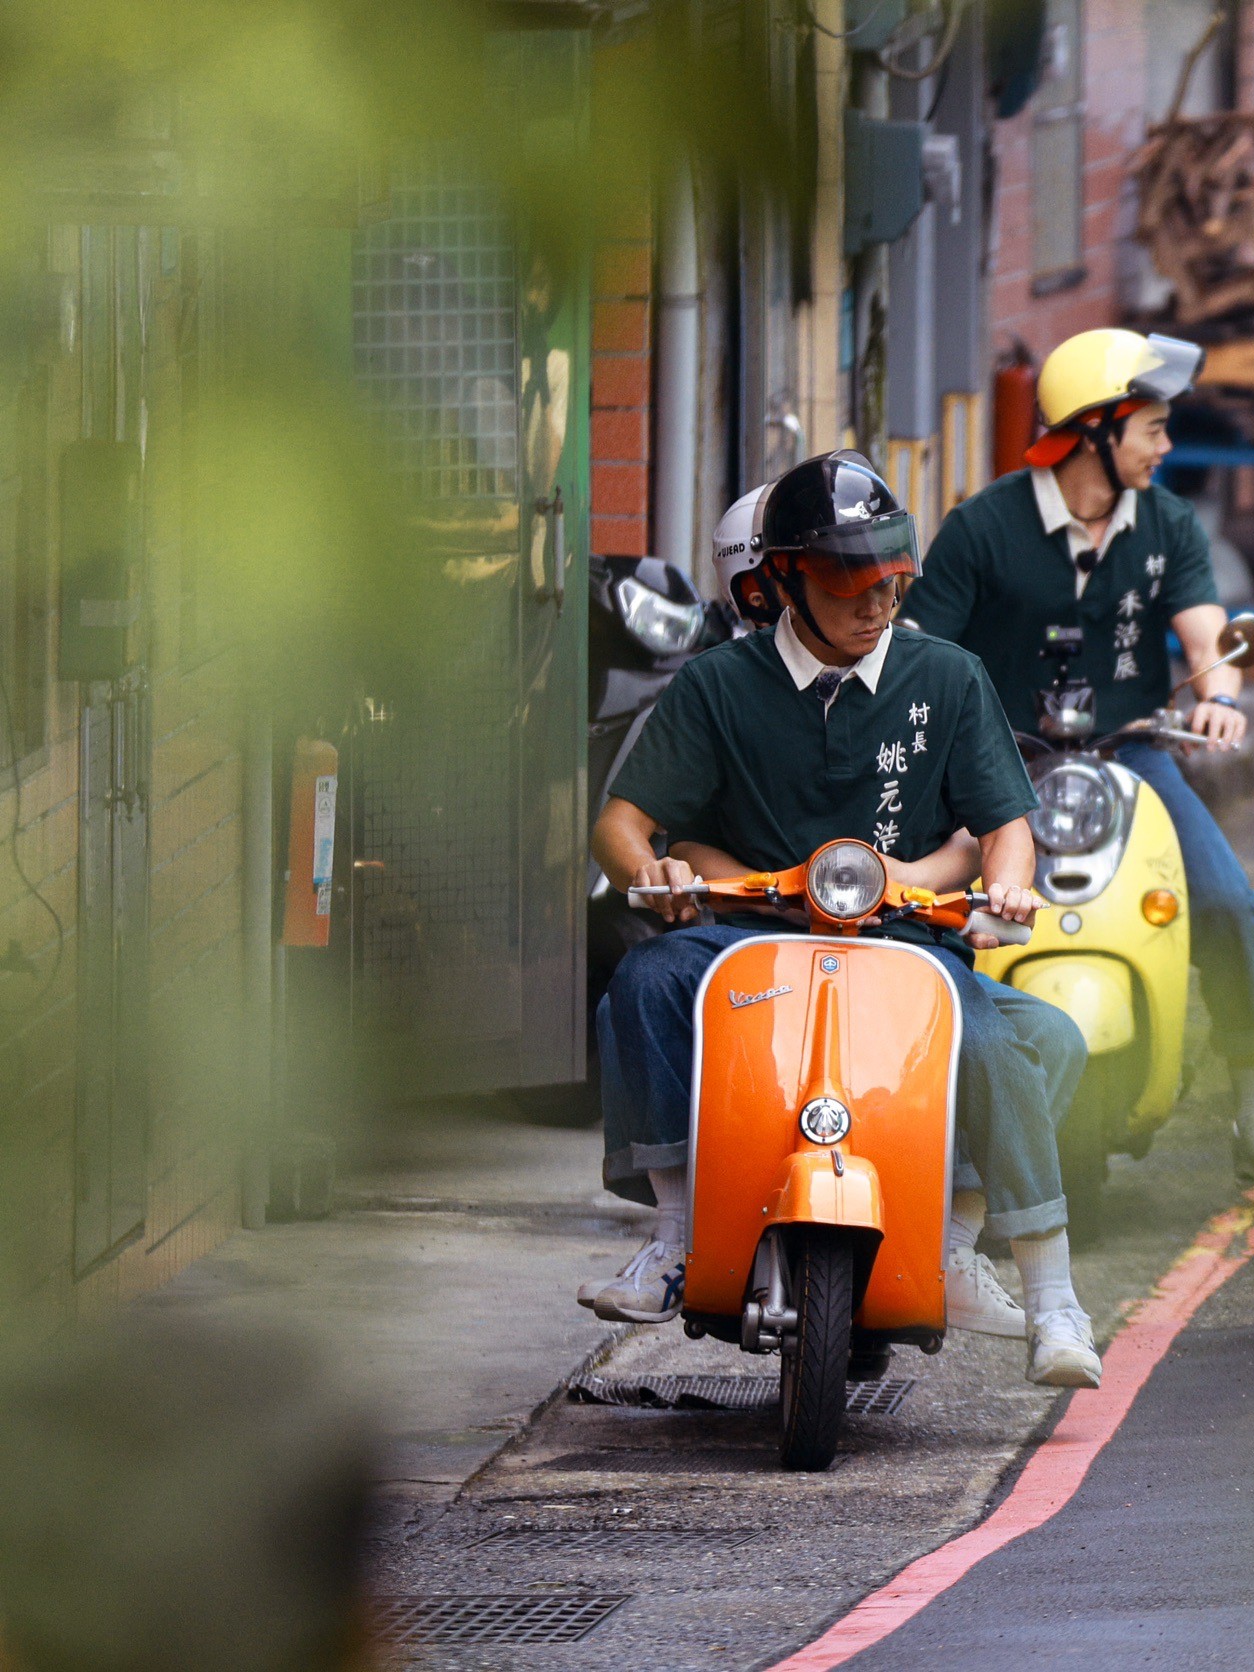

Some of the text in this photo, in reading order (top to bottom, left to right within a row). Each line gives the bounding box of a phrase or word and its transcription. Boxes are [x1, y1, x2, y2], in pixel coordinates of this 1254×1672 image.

[909, 702, 930, 753] 村長
[873, 740, 908, 853] 姚元浩
[729, 986, 793, 1008] Vespa
